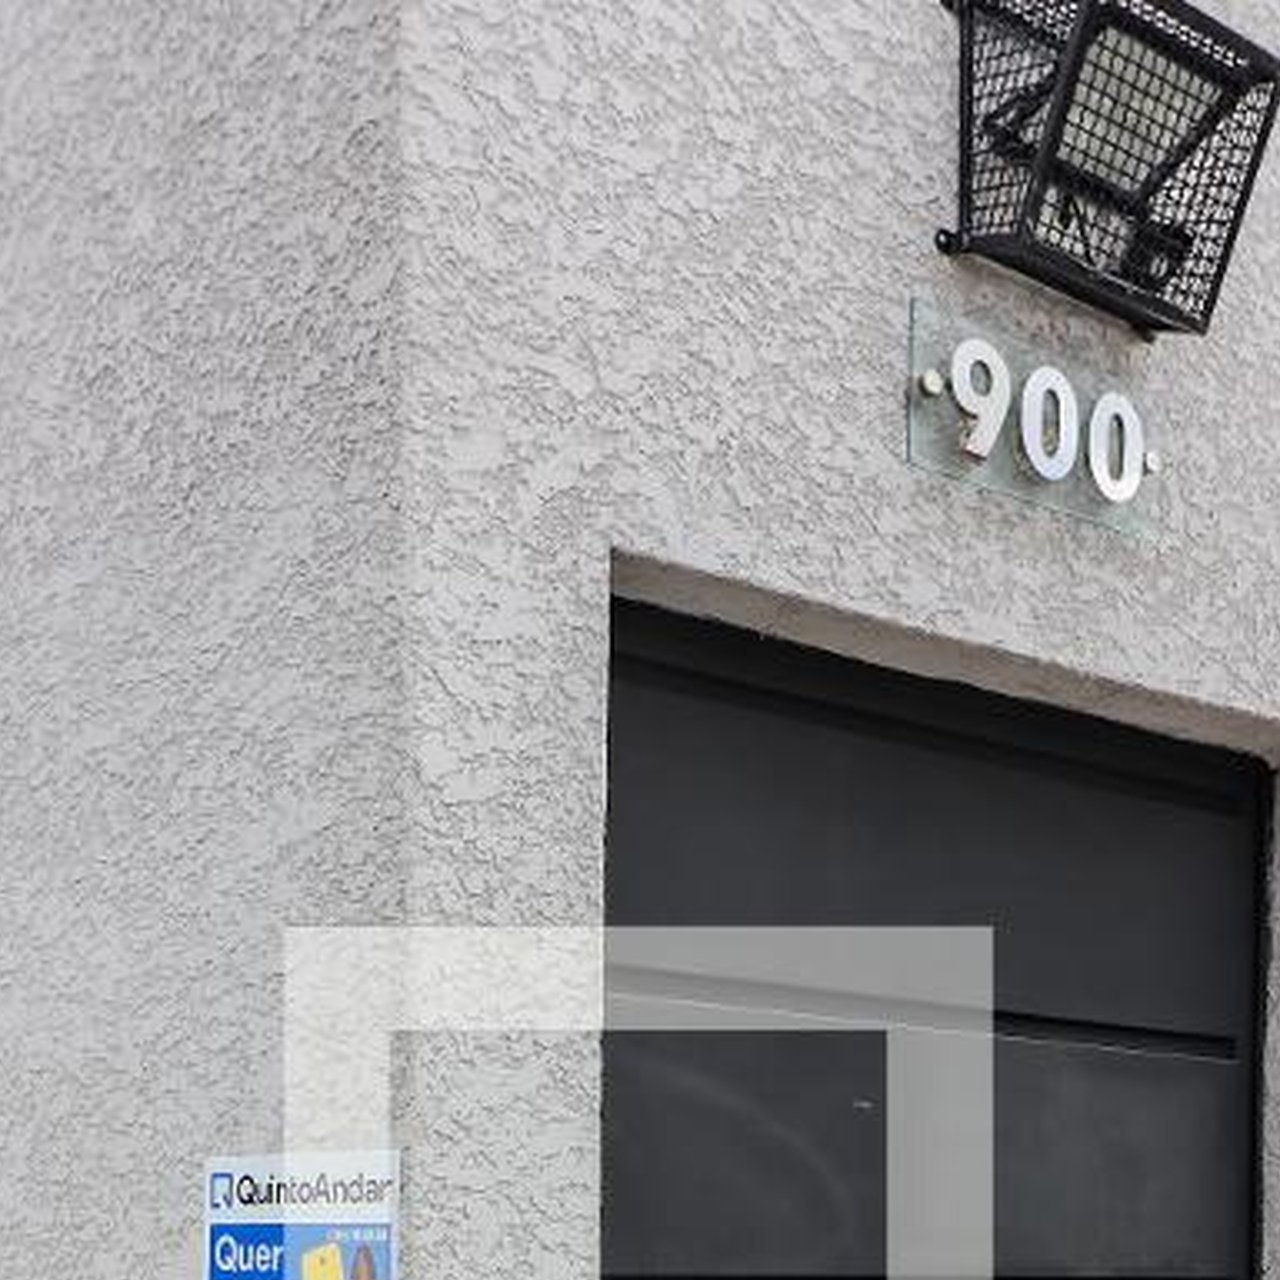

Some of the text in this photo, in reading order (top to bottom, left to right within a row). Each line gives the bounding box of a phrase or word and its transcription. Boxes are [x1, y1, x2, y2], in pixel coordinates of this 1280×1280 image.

[952, 339, 1145, 502] 900
[237, 1174, 394, 1206] QuintoAndar
[215, 1235, 285, 1274] Quer
